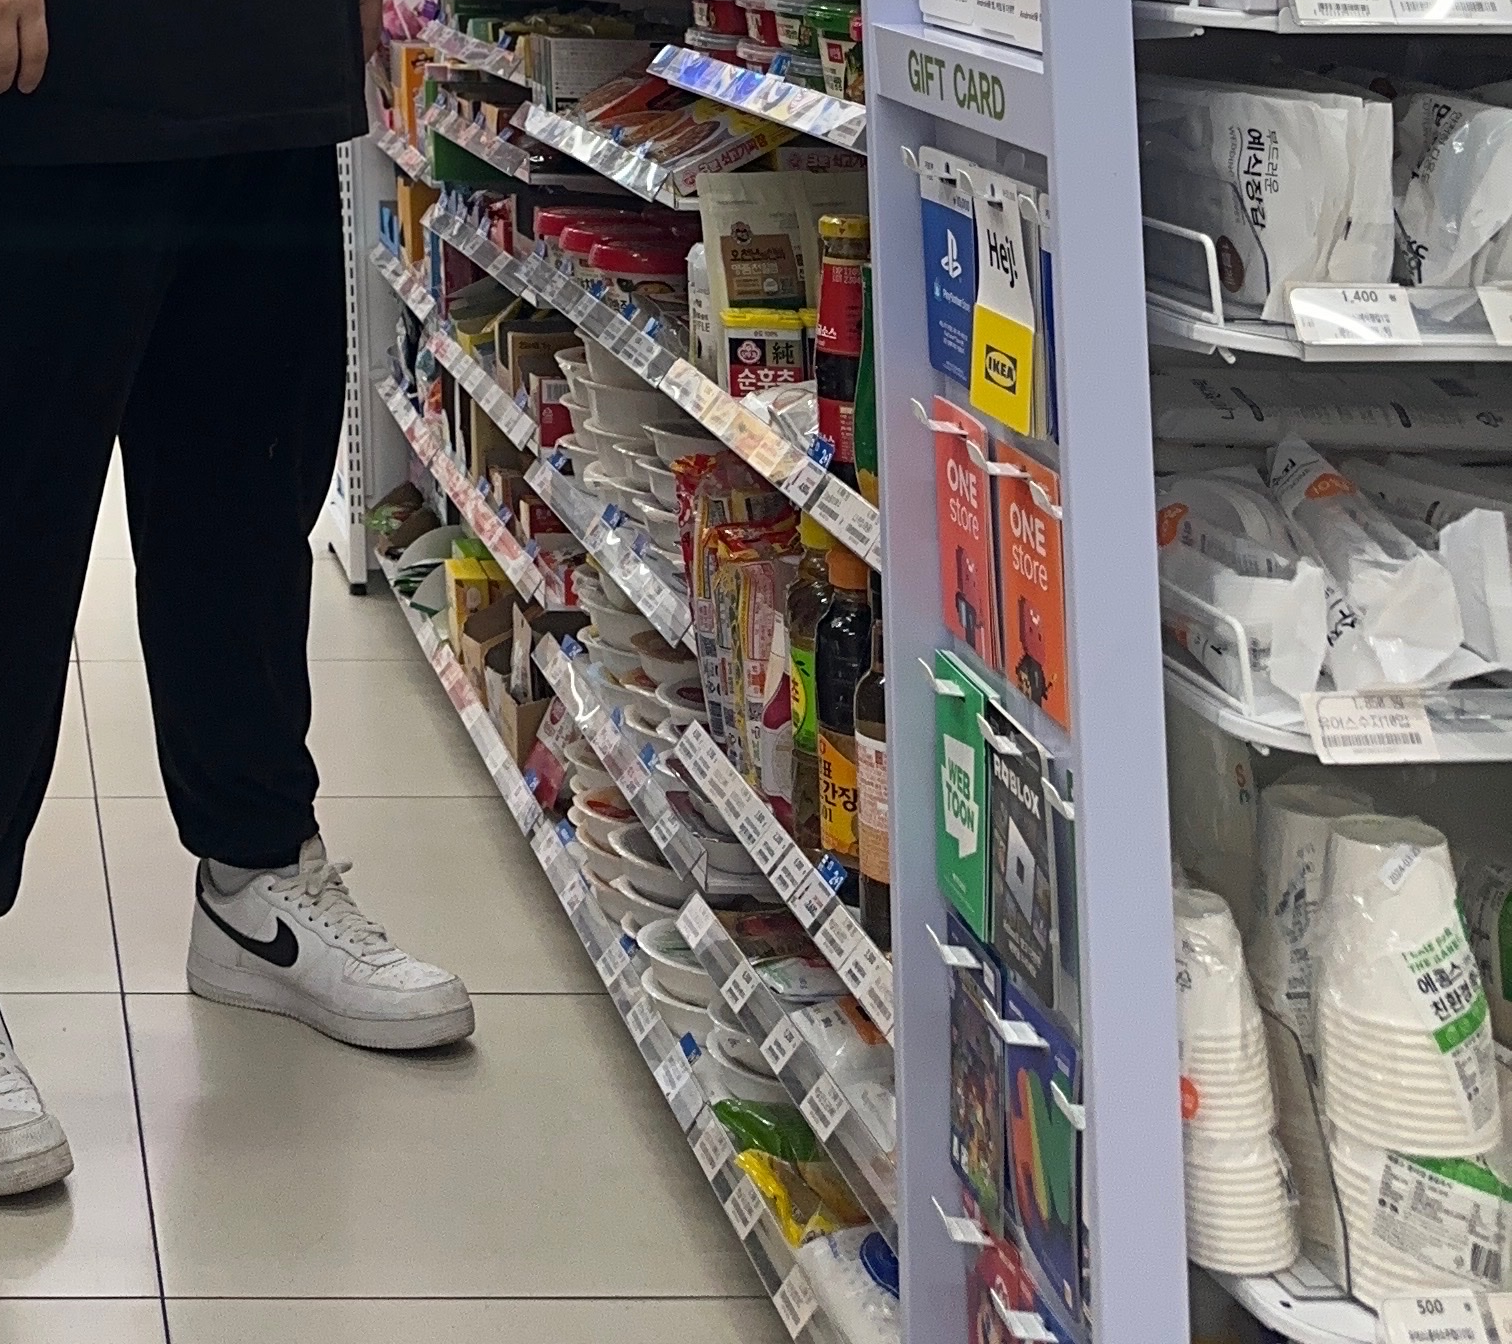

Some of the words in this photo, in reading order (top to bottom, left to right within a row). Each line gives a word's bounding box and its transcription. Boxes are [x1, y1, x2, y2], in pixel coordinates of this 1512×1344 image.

[907, 48, 945, 102] GIFT
[953, 63, 1006, 122] CARD
[986, 228, 1019, 290] Hej!
[1341, 289, 1379, 304] 1,400
[988, 355, 1015, 382] IKEA
[946, 458, 978, 509] ONE
[949, 497, 980, 541] store
[1009, 502, 1047, 558] ONE
[1011, 544, 1048, 592] store
[820, 785, 859, 813] 간장
[948, 758, 971, 798] WEB
[992, 752, 1041, 821] ROBLOX
[946, 780, 975, 831] TOON
[1417, 1299, 1444, 1314] 500
